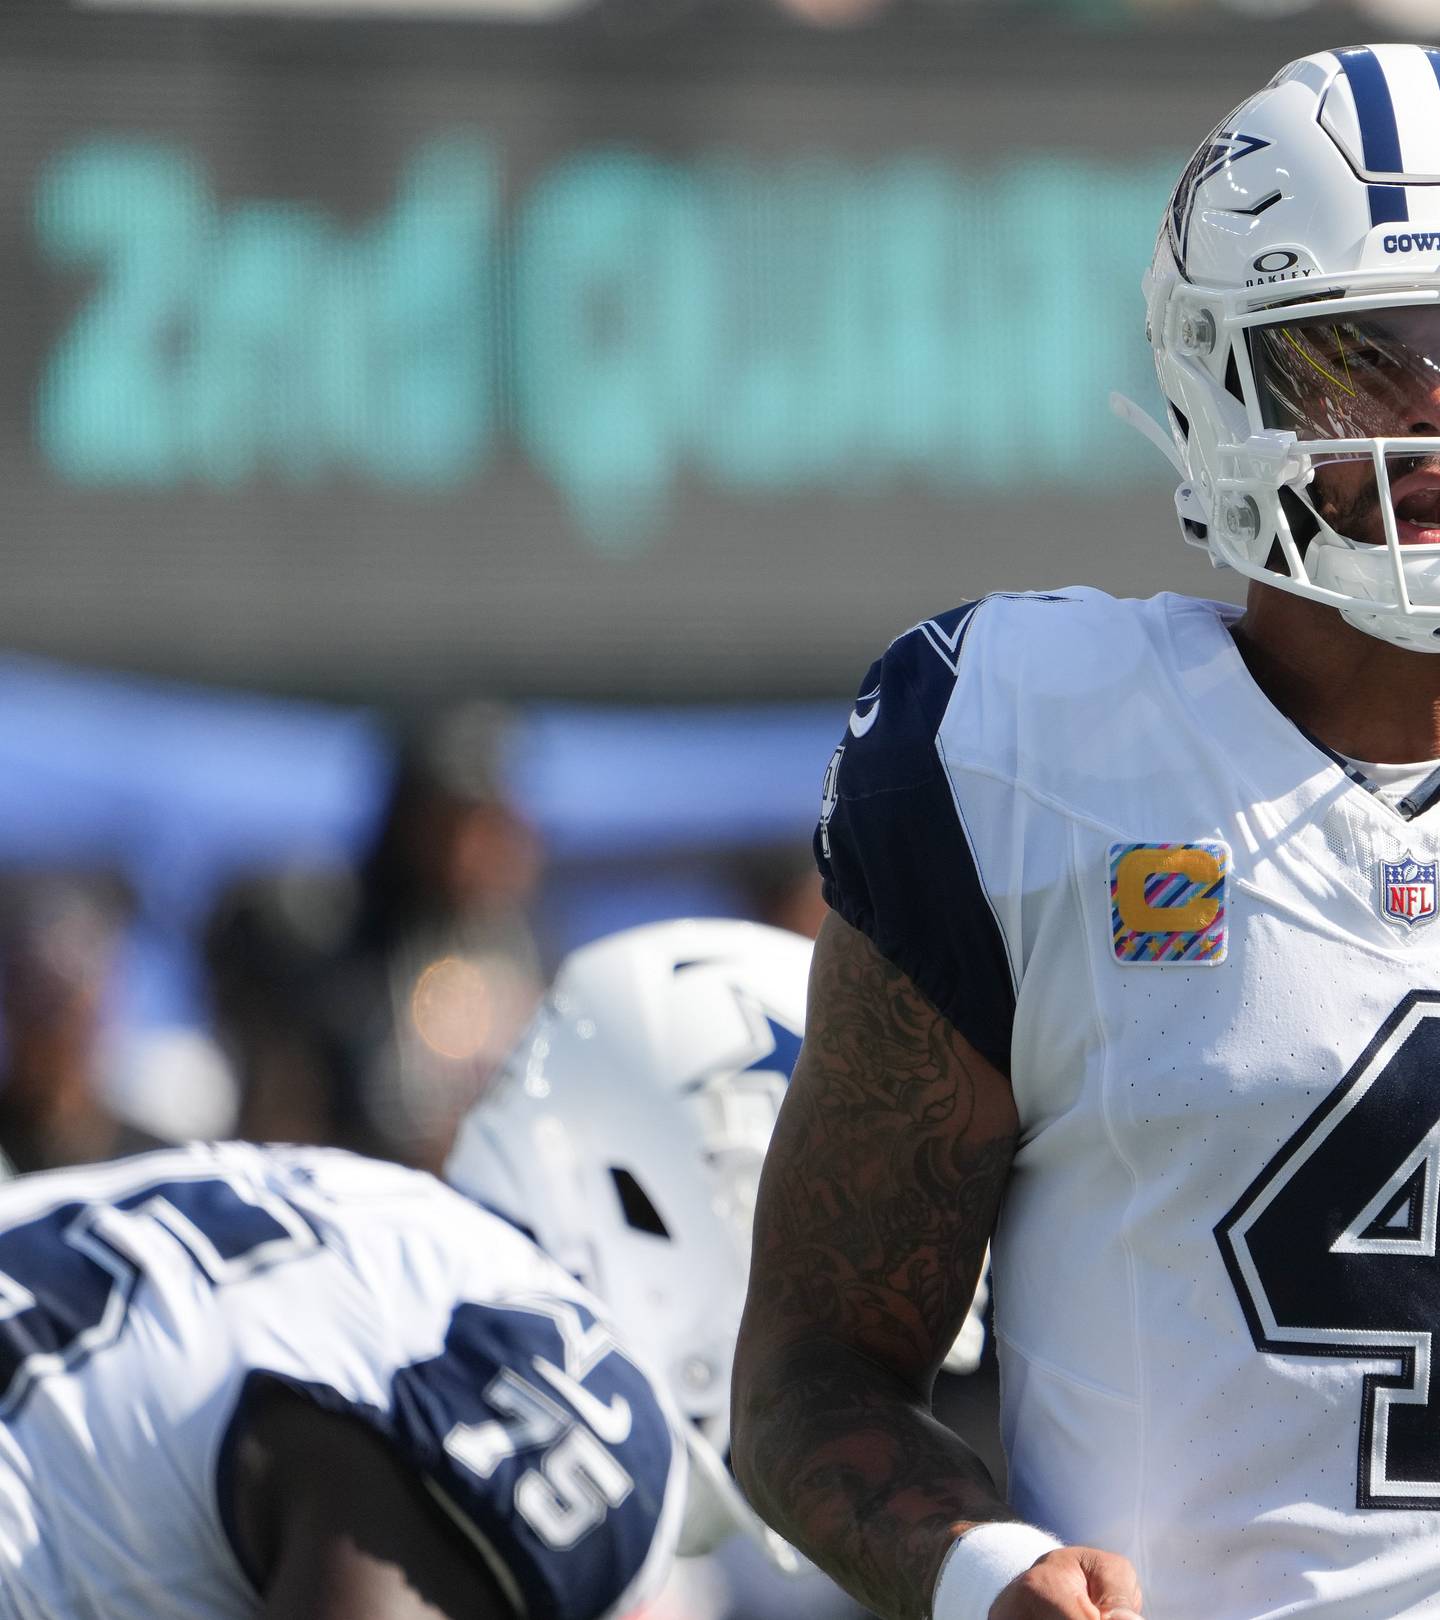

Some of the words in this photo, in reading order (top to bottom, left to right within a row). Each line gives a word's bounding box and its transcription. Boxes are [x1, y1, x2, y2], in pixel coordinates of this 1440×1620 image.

[36, 136, 502, 488] 2nd
[1115, 847, 1221, 933] C
[1390, 886, 1432, 917] NFL
[442, 1366, 635, 1552] 75
